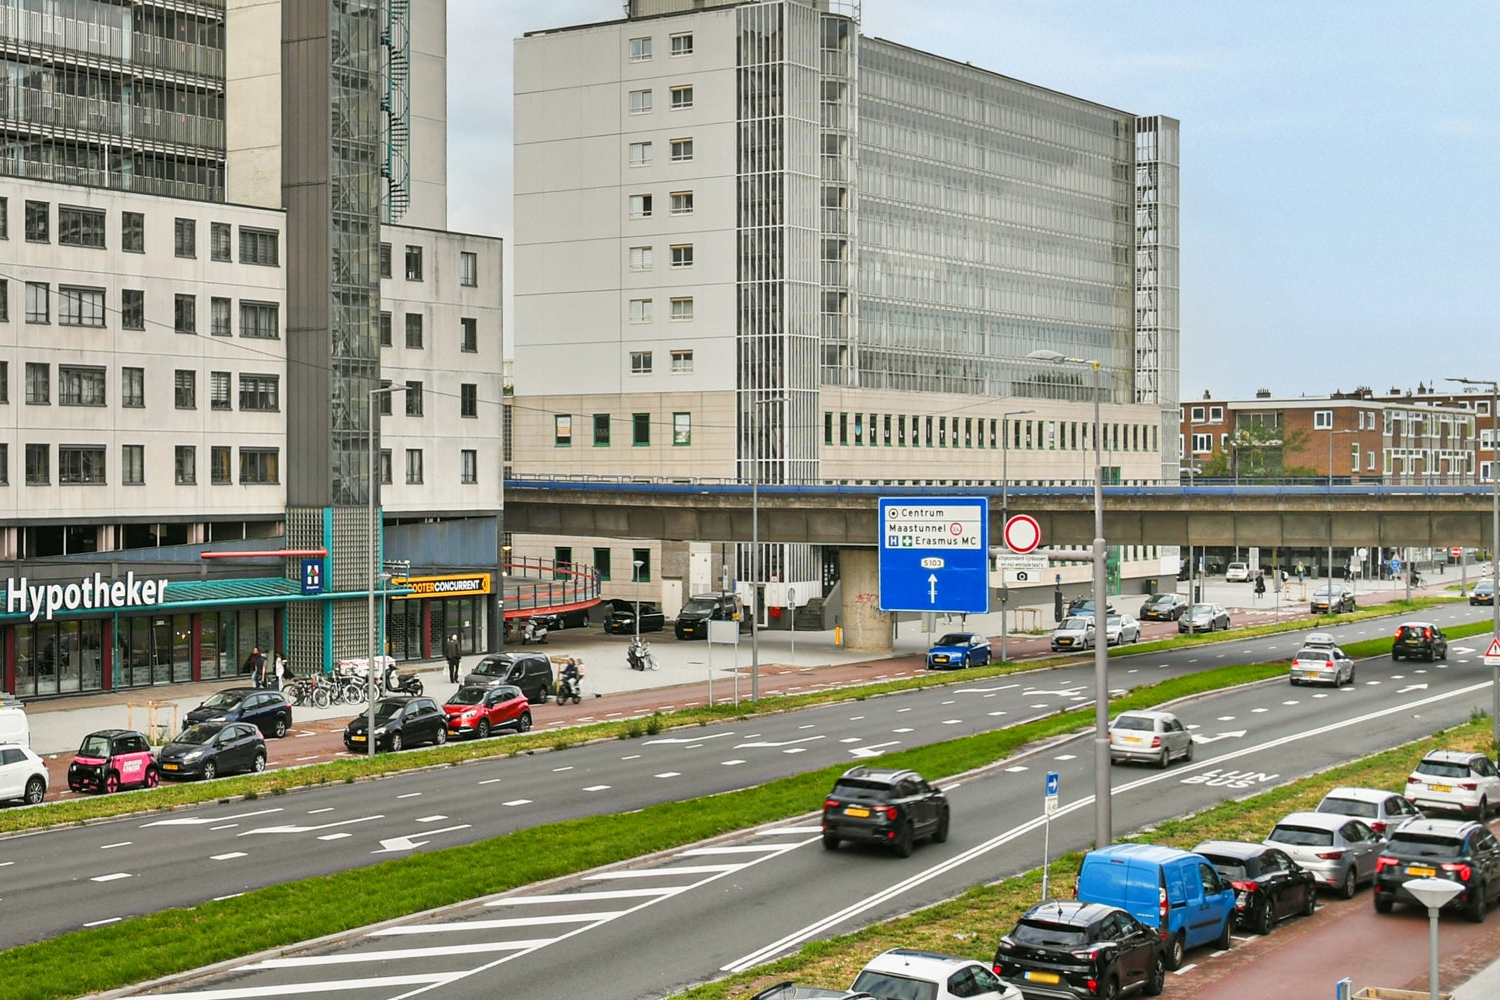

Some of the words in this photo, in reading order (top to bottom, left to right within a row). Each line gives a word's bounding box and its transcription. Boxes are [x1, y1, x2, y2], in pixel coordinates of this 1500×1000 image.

[901, 509, 944, 517] Centrum
[915, 537, 958, 545] Erasmus
[962, 537, 977, 545] MC
[6, 570, 169, 622] Hypotheker
[1180, 775, 1256, 789] BUS
[1202, 769, 1280, 782] LIJN
